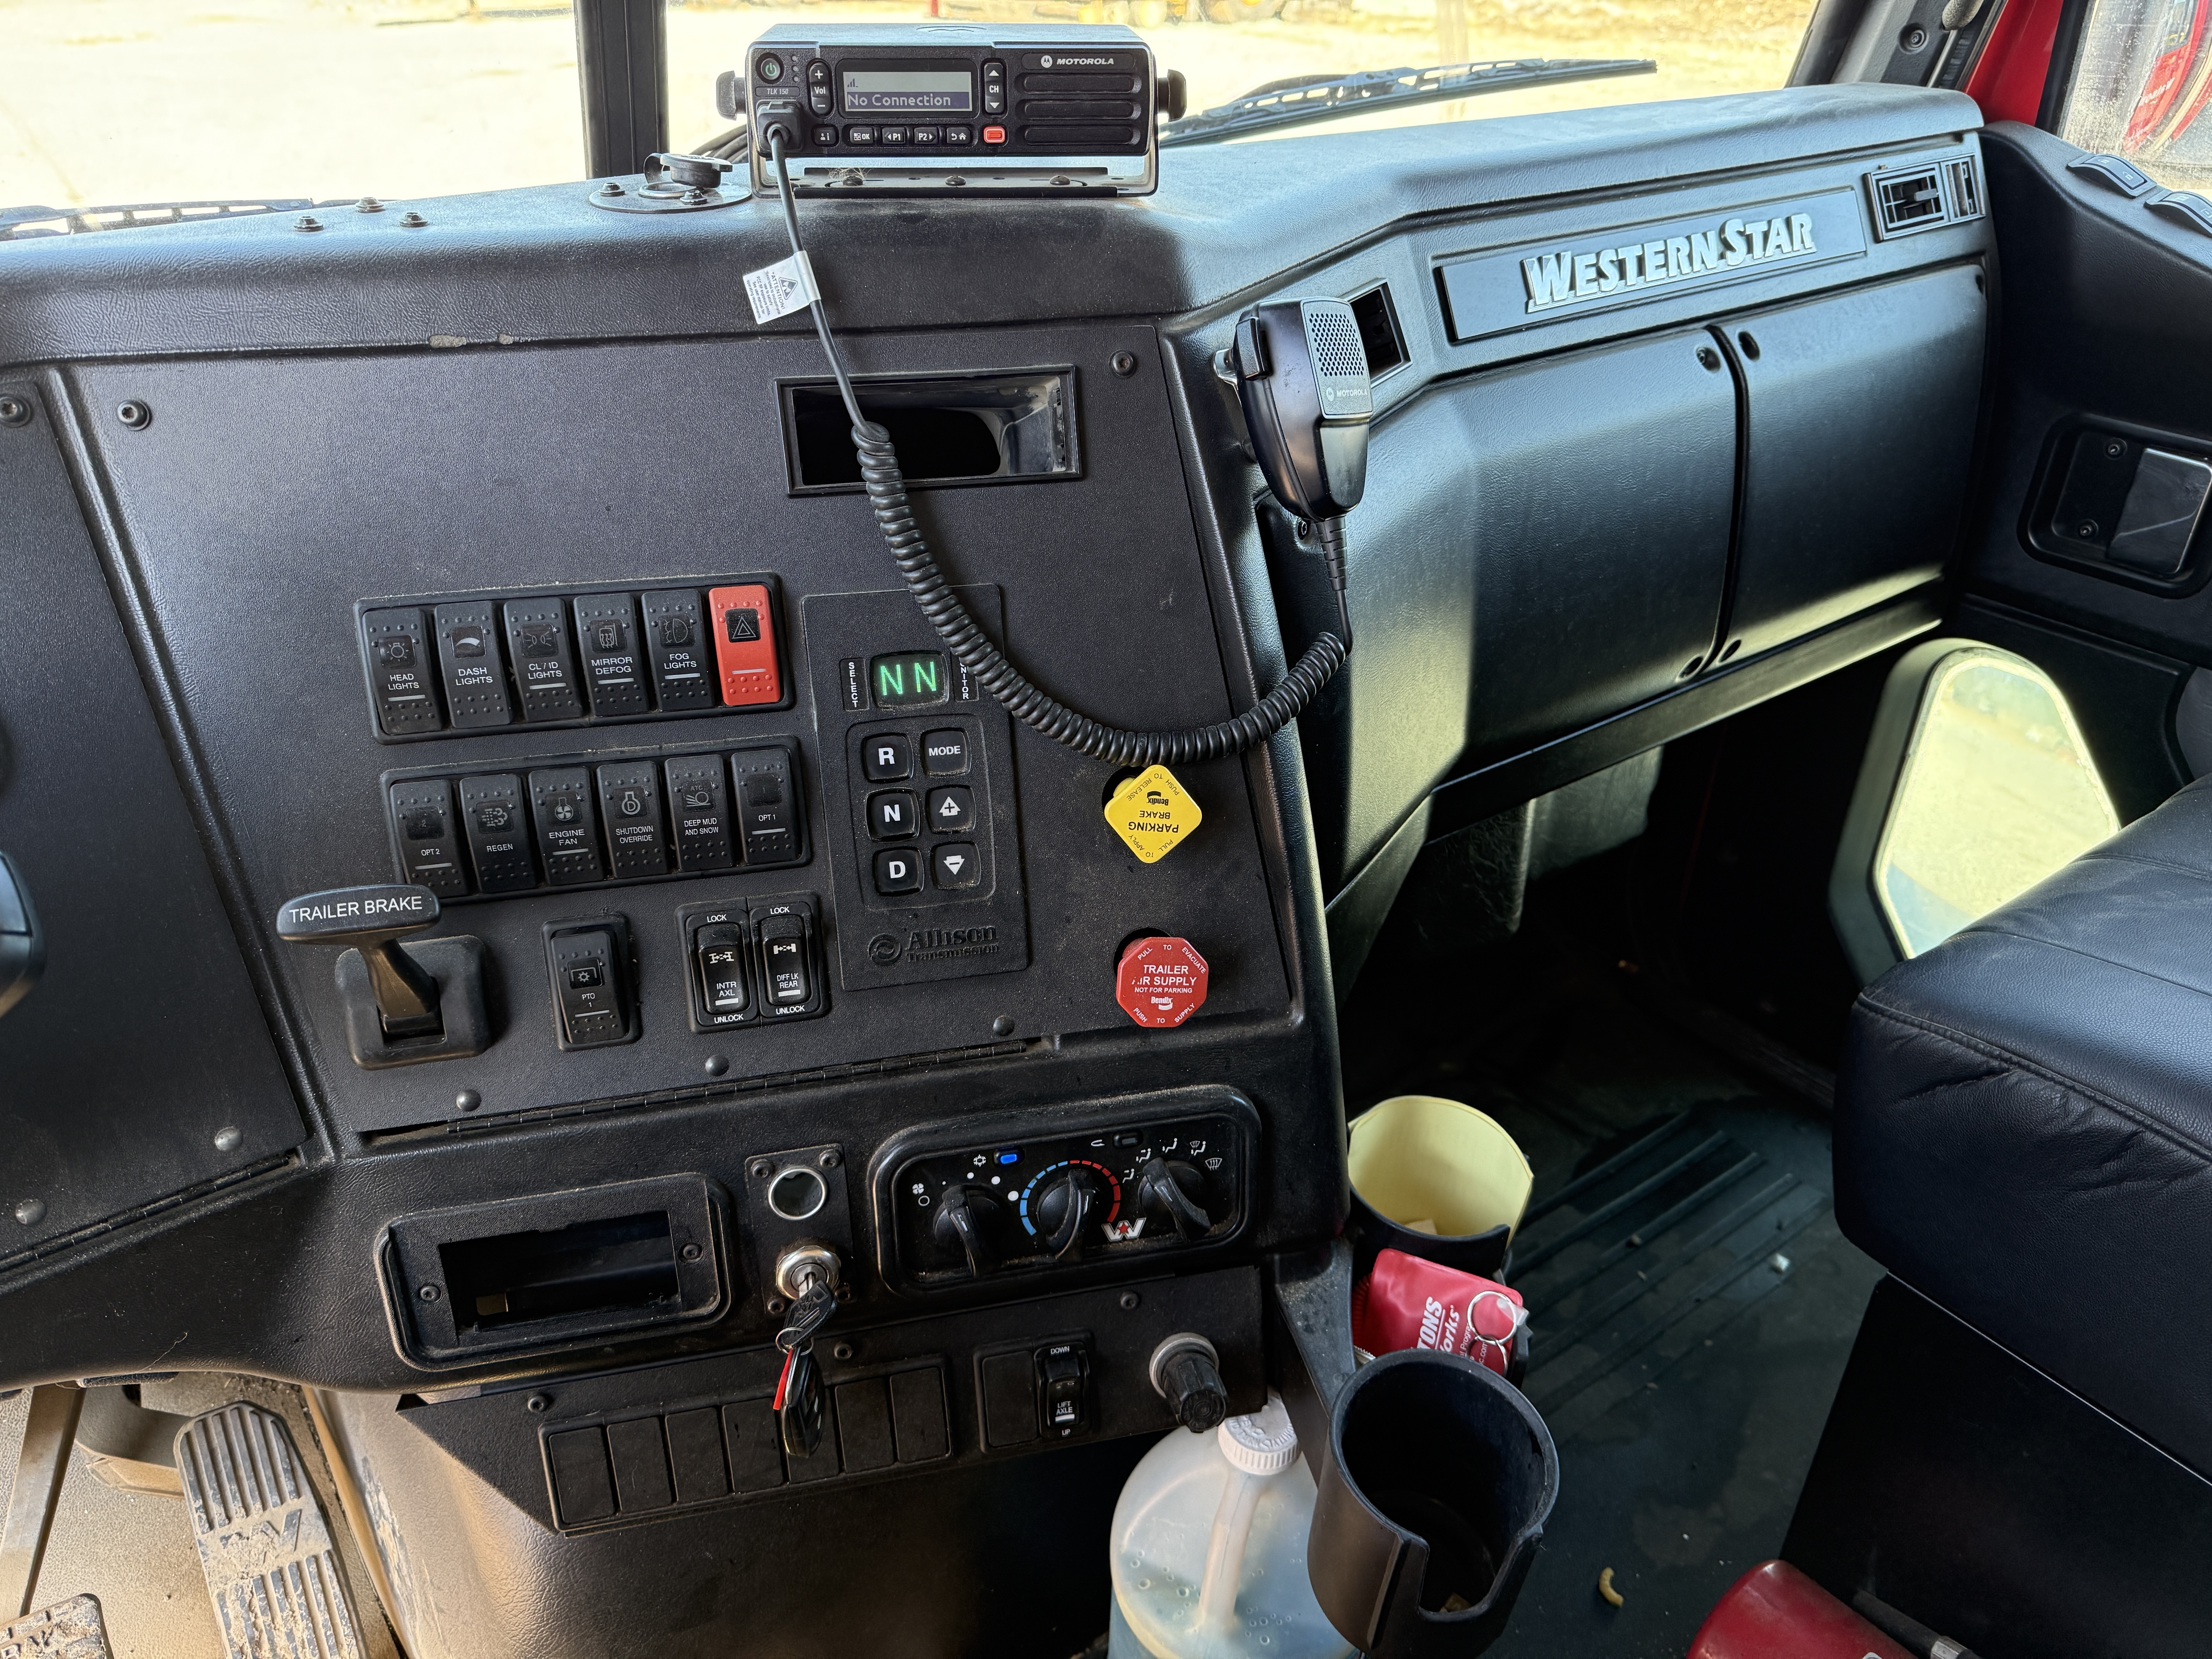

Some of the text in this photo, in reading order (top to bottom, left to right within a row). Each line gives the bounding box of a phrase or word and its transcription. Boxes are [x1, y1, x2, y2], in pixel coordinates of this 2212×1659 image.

[989, 85, 999, 93] CH
[848, 93, 951, 106] No Connection
[746, 280, 754, 296] operating
[1336, 389, 1367, 397] MOTOROLA
[591, 657, 633, 666] MIRROR
[664, 661, 697, 669] LIGHTS
[458, 667, 487, 677] DASH
[528, 670, 562, 679] LIGHTS
[595, 666, 632, 675] DEFOG
[390, 673, 414, 682] HEAD
[456, 676, 493, 685] LIGHTS
[388, 682, 419, 690] LIGHTS
[848, 662, 859, 708] SELECT
[929, 745, 961, 756] MODE
[878, 748, 895, 765] R
[1127, 778, 1152, 801] RELEASE
[1165, 779, 1180, 796] PUSH
[1146, 798, 1169, 806] Bendix
[883, 804, 901, 823] N
[1139, 810, 1170, 819] BRAKE
[684, 819, 701, 828] DEEP
[1128, 821, 1179, 833] PARKING
[549, 829, 585, 839] ENGINE
[616, 825, 654, 836] SHUTDOWN
[685, 826, 719, 836] AND SNOW
[620, 835, 653, 844] OVERRIDE
[1128, 835, 1145, 851] APPLY
[486, 843, 513, 852] REGEN
[1158, 839, 1174, 852] PULL
[889, 861, 906, 879] D
[289, 896, 422, 924] TRAILER BRAKE
[769, 906, 790, 915] LOCK
[706, 914, 727, 923] LOCK
[905, 926, 998, 950] Allison
[1137, 946, 1153, 960] PULL
[1182, 946, 1206, 974] EVACUATE
[1144, 965, 1188, 974] TRAILER
[776, 974, 790, 982] DIFF
[1154, 977, 1197, 986] SUPPLY
[779, 980, 799, 989] REAR
[581, 993, 596, 1001] PTO
[719, 989, 735, 998] AXL
[776, 1005, 805, 1015] UNLOCK
[1133, 1007, 1148, 1023] PUSH
[1174, 1003, 1195, 1023] SUPPLY
[714, 1013, 744, 1024] UNLOCK
[1441, 1309, 1460, 1352] orks
[1460, 1323, 1470, 1350] Progra
[1050, 1346, 1070, 1355] DOWN
[1056, 1407, 1072, 1415] AXLE
[1062, 1429, 1070, 1437] UP
